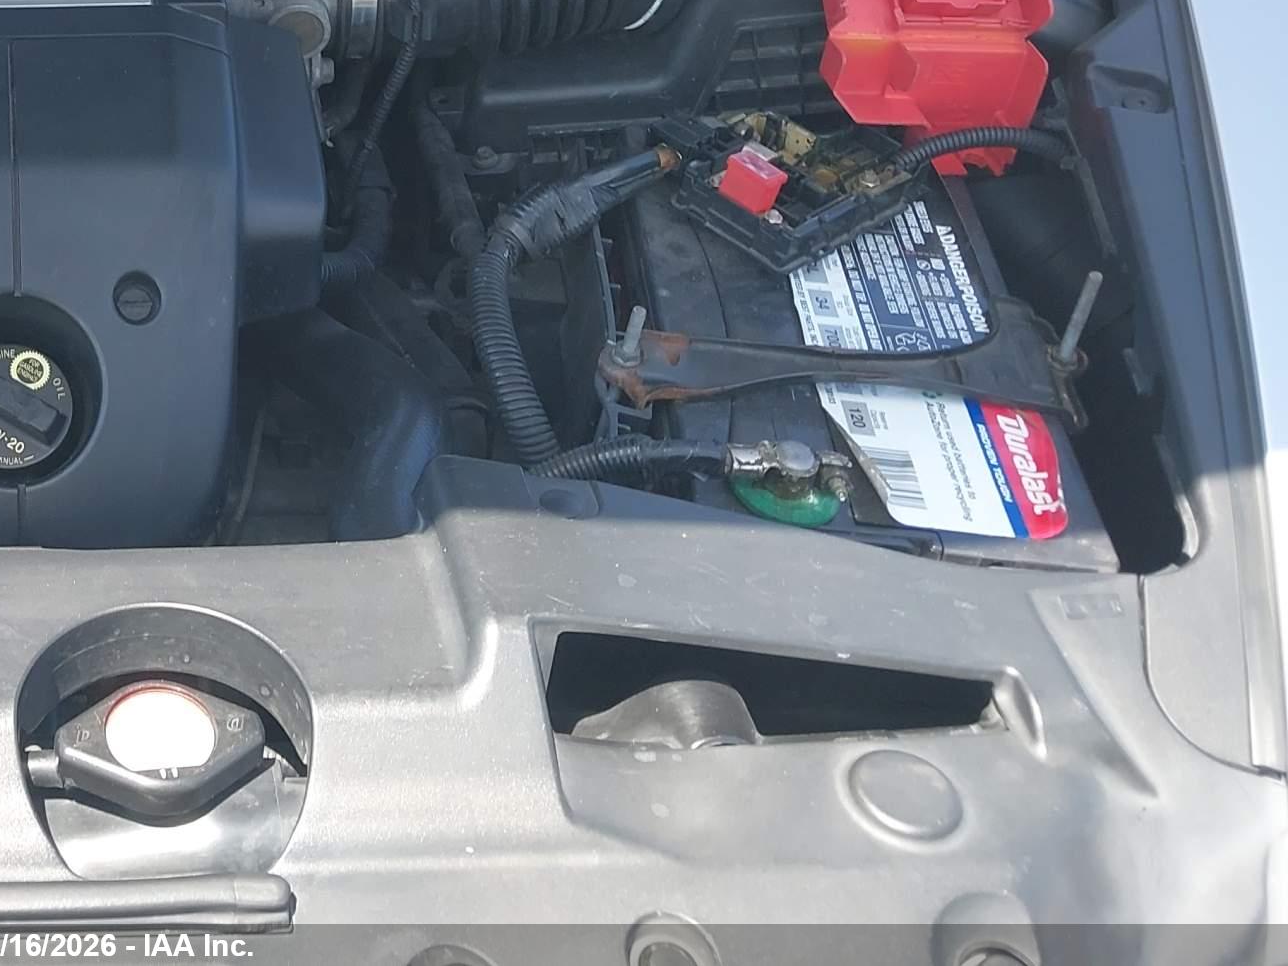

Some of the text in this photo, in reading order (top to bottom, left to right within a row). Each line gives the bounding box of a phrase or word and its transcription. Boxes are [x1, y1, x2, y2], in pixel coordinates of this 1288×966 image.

[52, 377, 66, 400] OIL
[847, 407, 867, 429] 120
[976, 423, 1013, 503] PROVEN TOUGH
[996, 414, 1061, 515] Duralast
